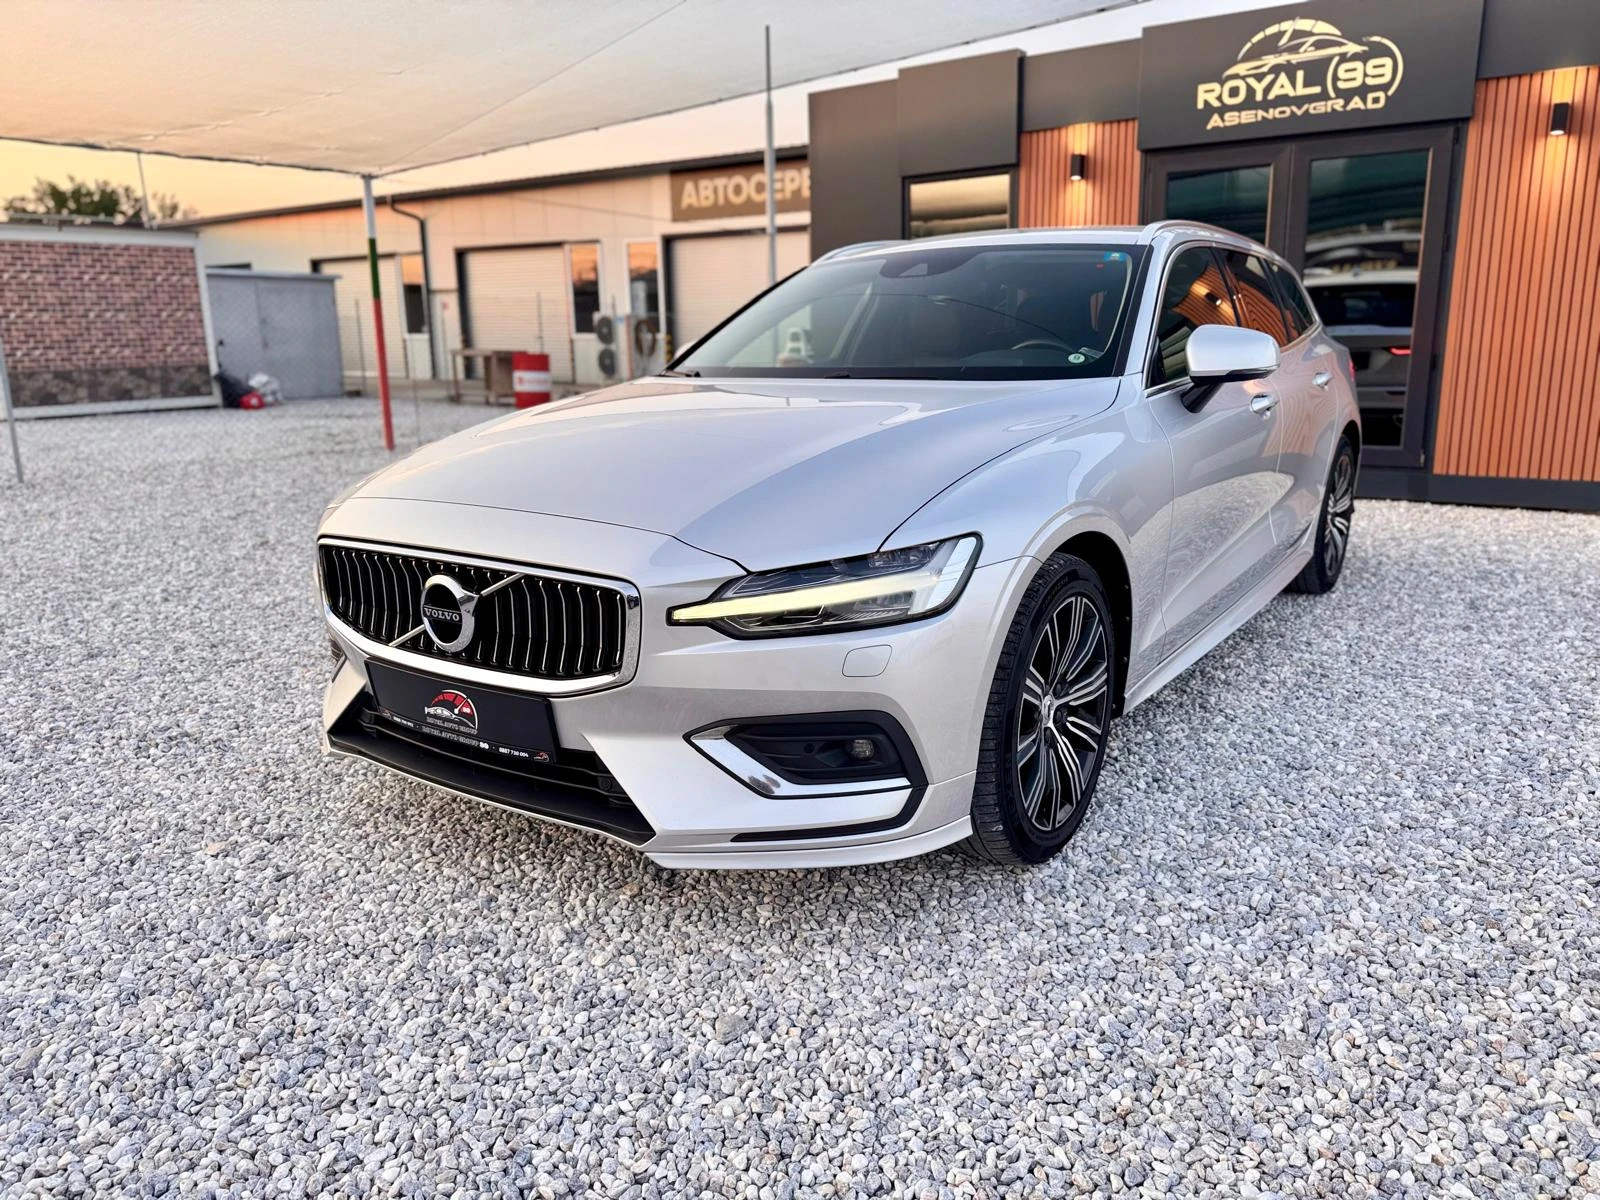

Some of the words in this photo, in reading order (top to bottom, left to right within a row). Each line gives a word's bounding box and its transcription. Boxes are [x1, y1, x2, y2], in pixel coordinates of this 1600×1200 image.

[1197, 70, 1321, 109] ROYAL
[1206, 91, 1386, 130] ASENOVGRAD
[424, 608, 460, 621] VOLVO
